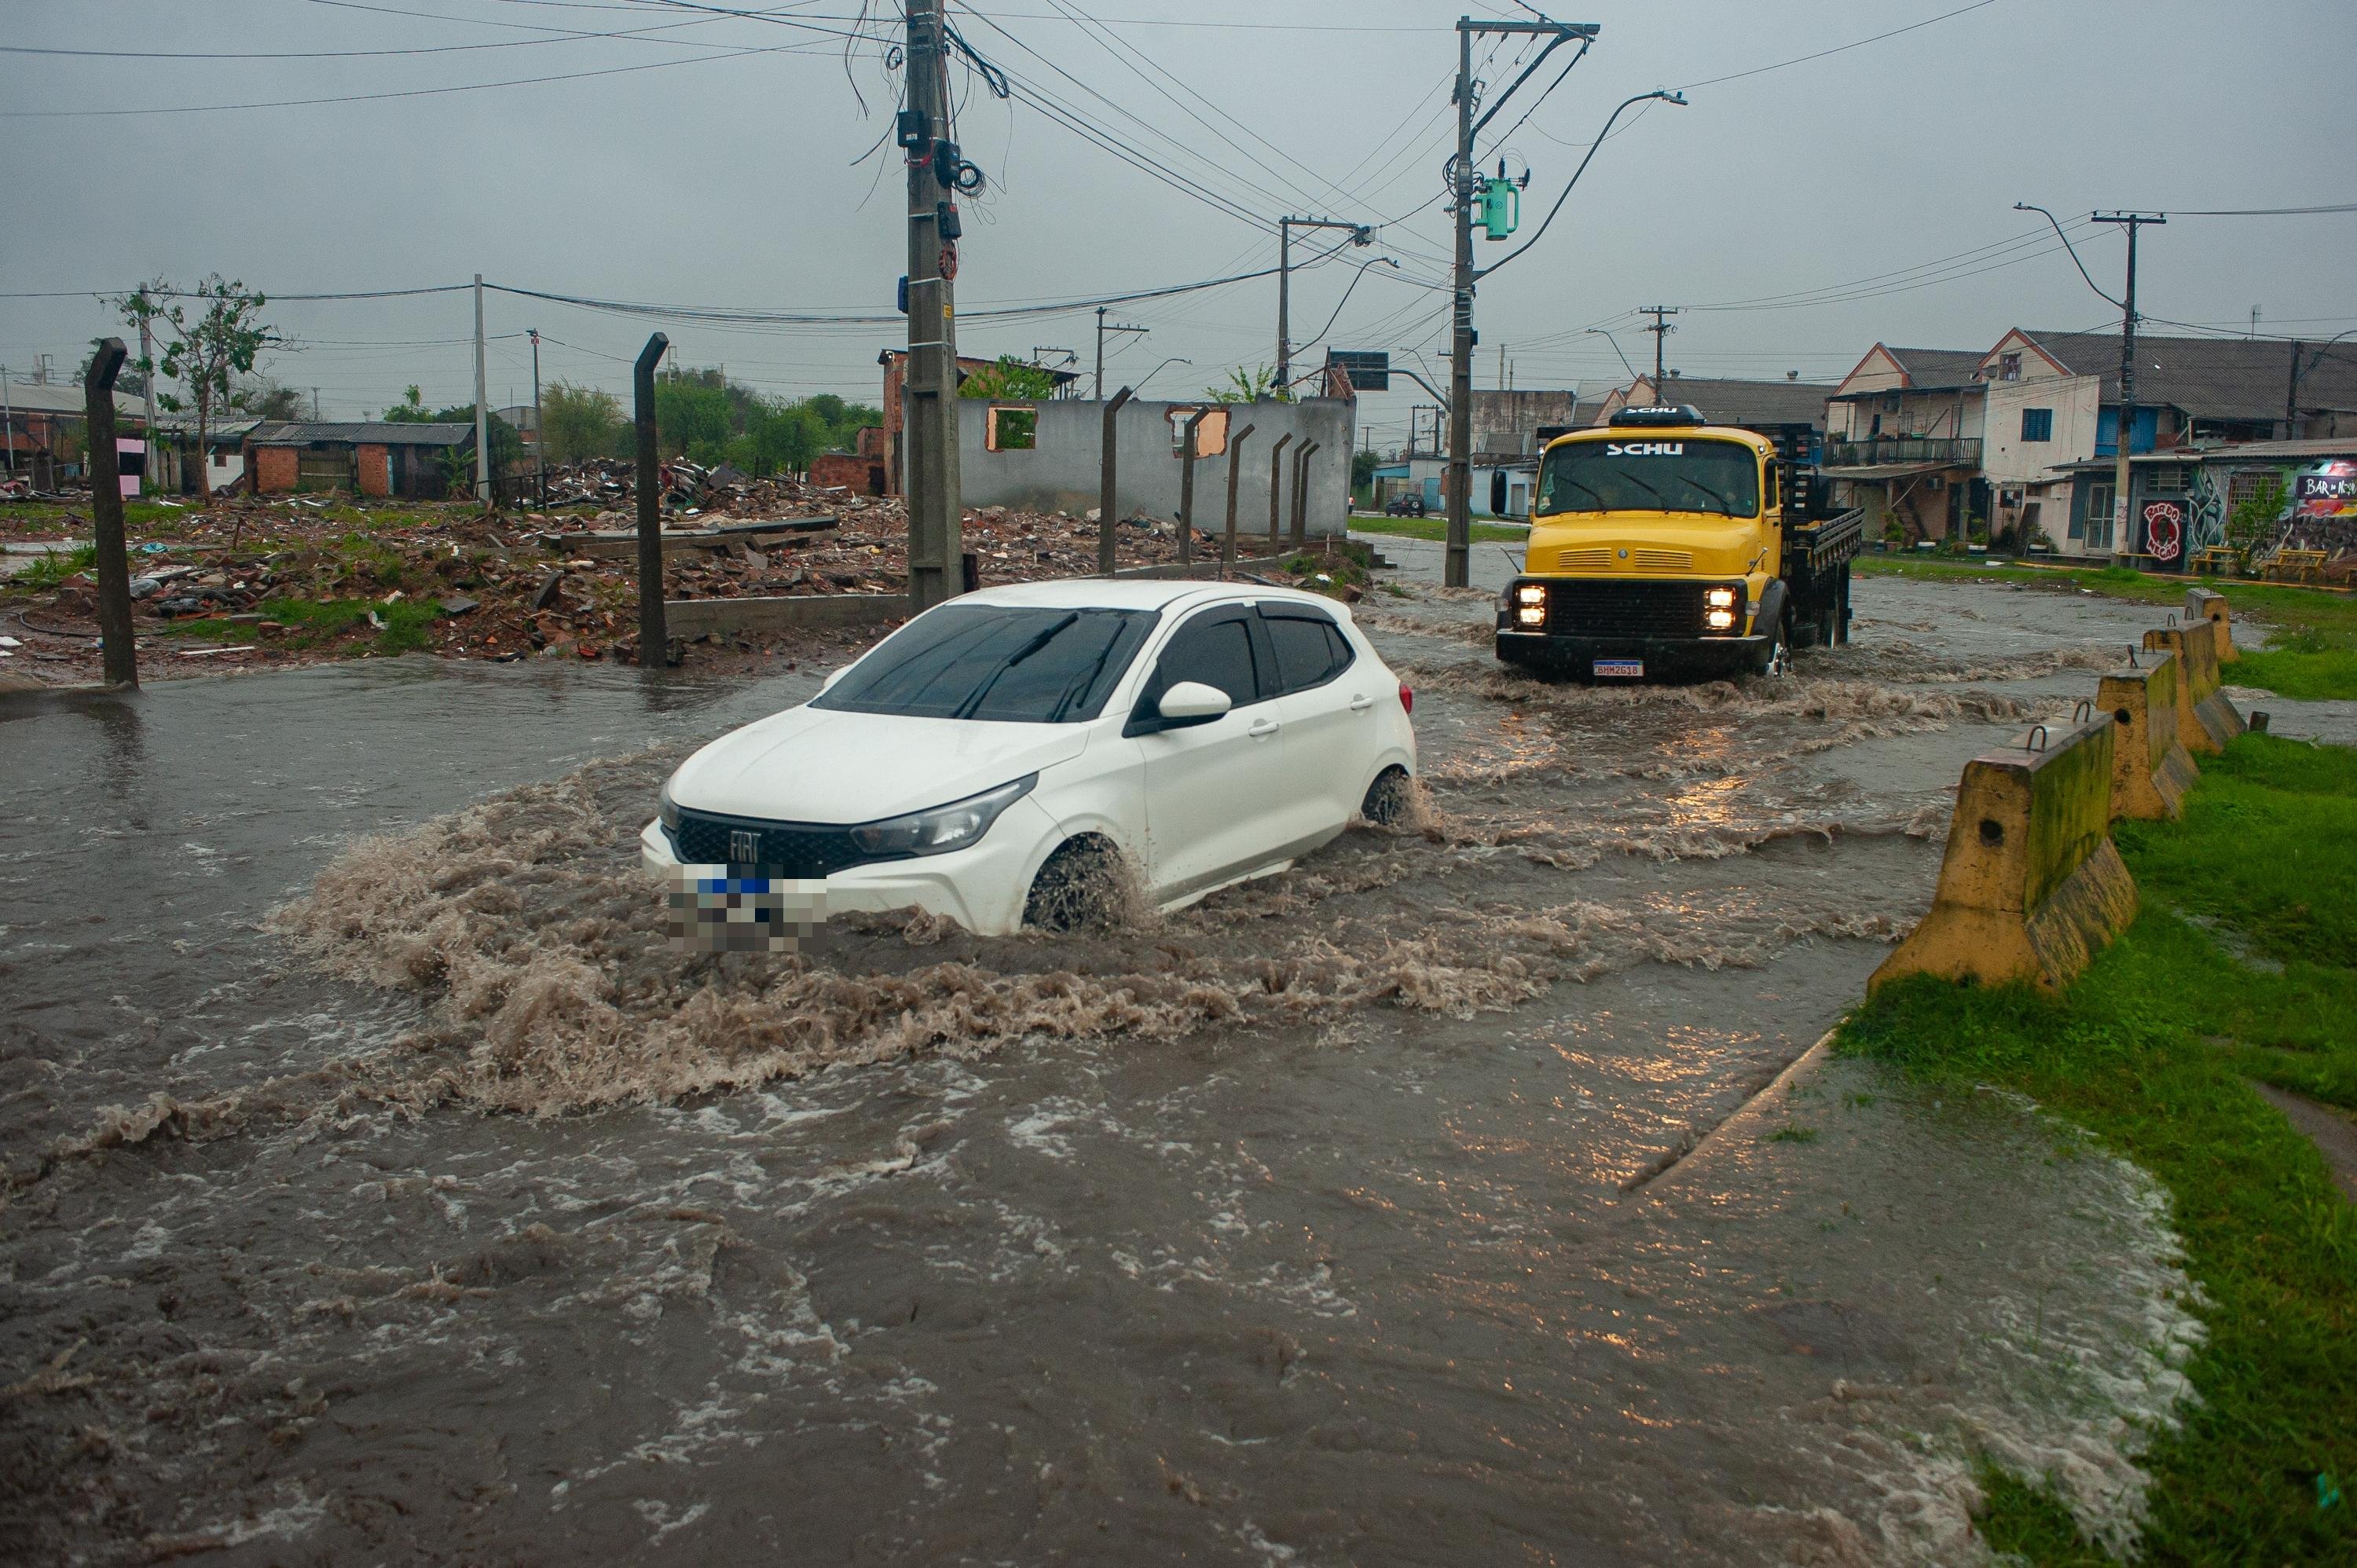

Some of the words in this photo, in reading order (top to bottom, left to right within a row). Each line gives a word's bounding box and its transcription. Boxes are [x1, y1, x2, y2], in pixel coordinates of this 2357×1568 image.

[1607, 444, 1683, 456] SCHU
[2305, 478, 2330, 496] BAR
[2144, 504, 2166, 520] BAR
[2165, 504, 2179, 522] DO
[2146, 539, 2179, 560] NEGÃO
[731, 830, 761, 863] FIAT
